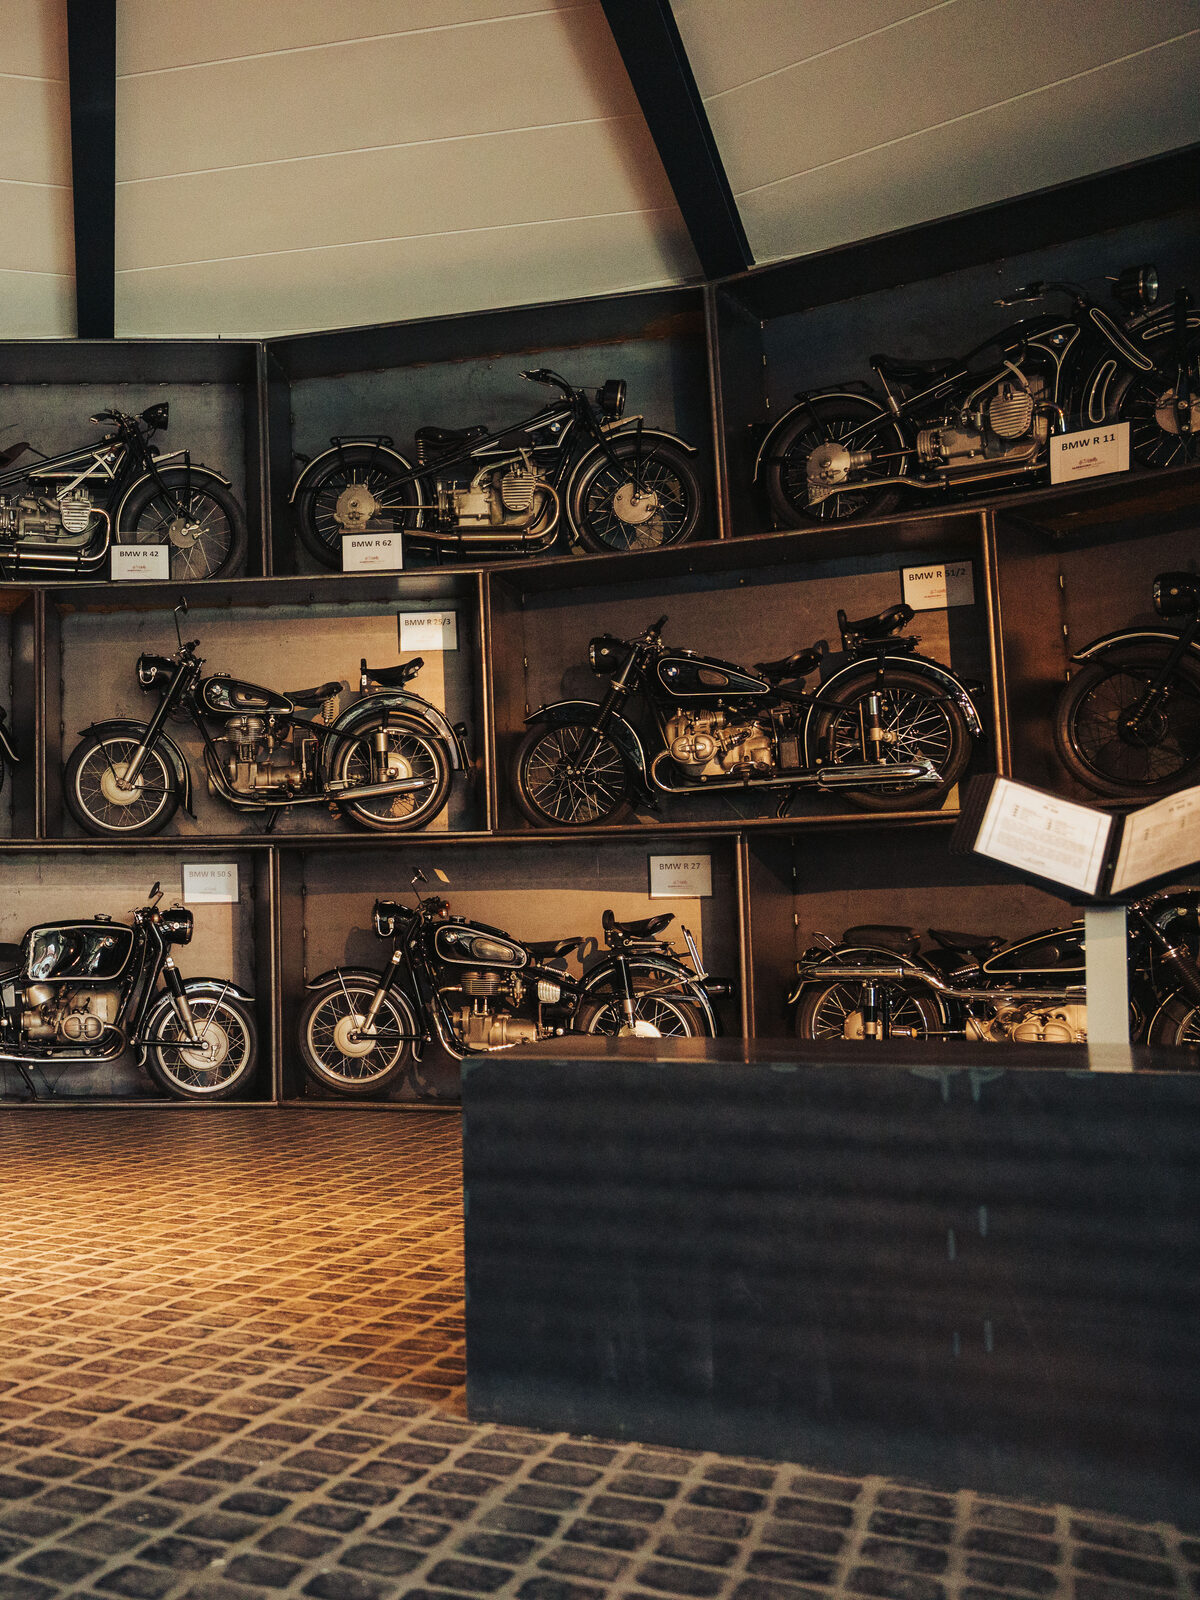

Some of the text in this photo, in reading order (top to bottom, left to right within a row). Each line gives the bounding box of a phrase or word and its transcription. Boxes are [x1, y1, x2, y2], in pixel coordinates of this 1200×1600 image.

[1062, 433, 1115, 452] BMW R 11
[909, 571, 934, 581] BMW
[936, 570, 942, 578] R
[659, 862, 682, 870] BMW
[691, 862, 700, 870] 27
